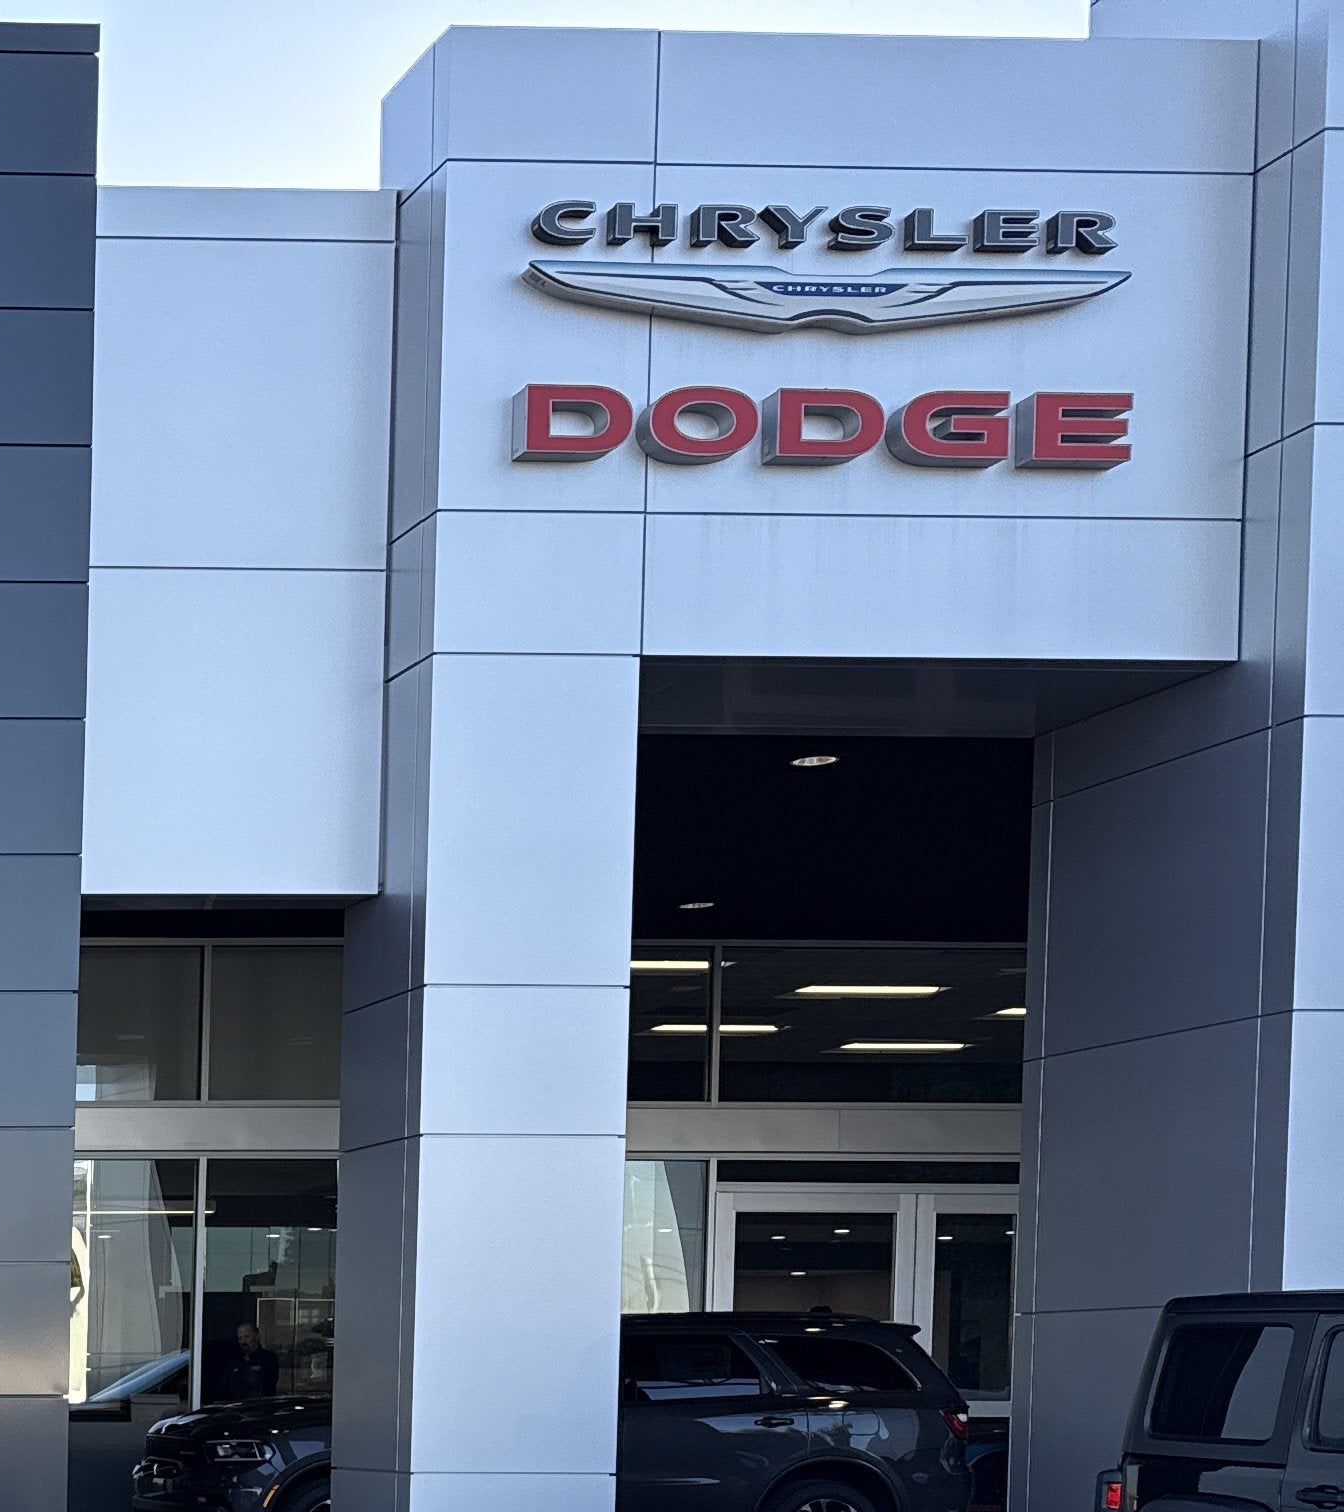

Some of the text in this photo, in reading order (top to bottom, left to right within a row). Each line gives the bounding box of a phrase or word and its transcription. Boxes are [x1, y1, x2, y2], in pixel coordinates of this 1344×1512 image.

[532, 200, 1118, 254] CHRYSLER
[771, 283, 888, 295] CHRYSLER
[512, 384, 1134, 469] DODGE
